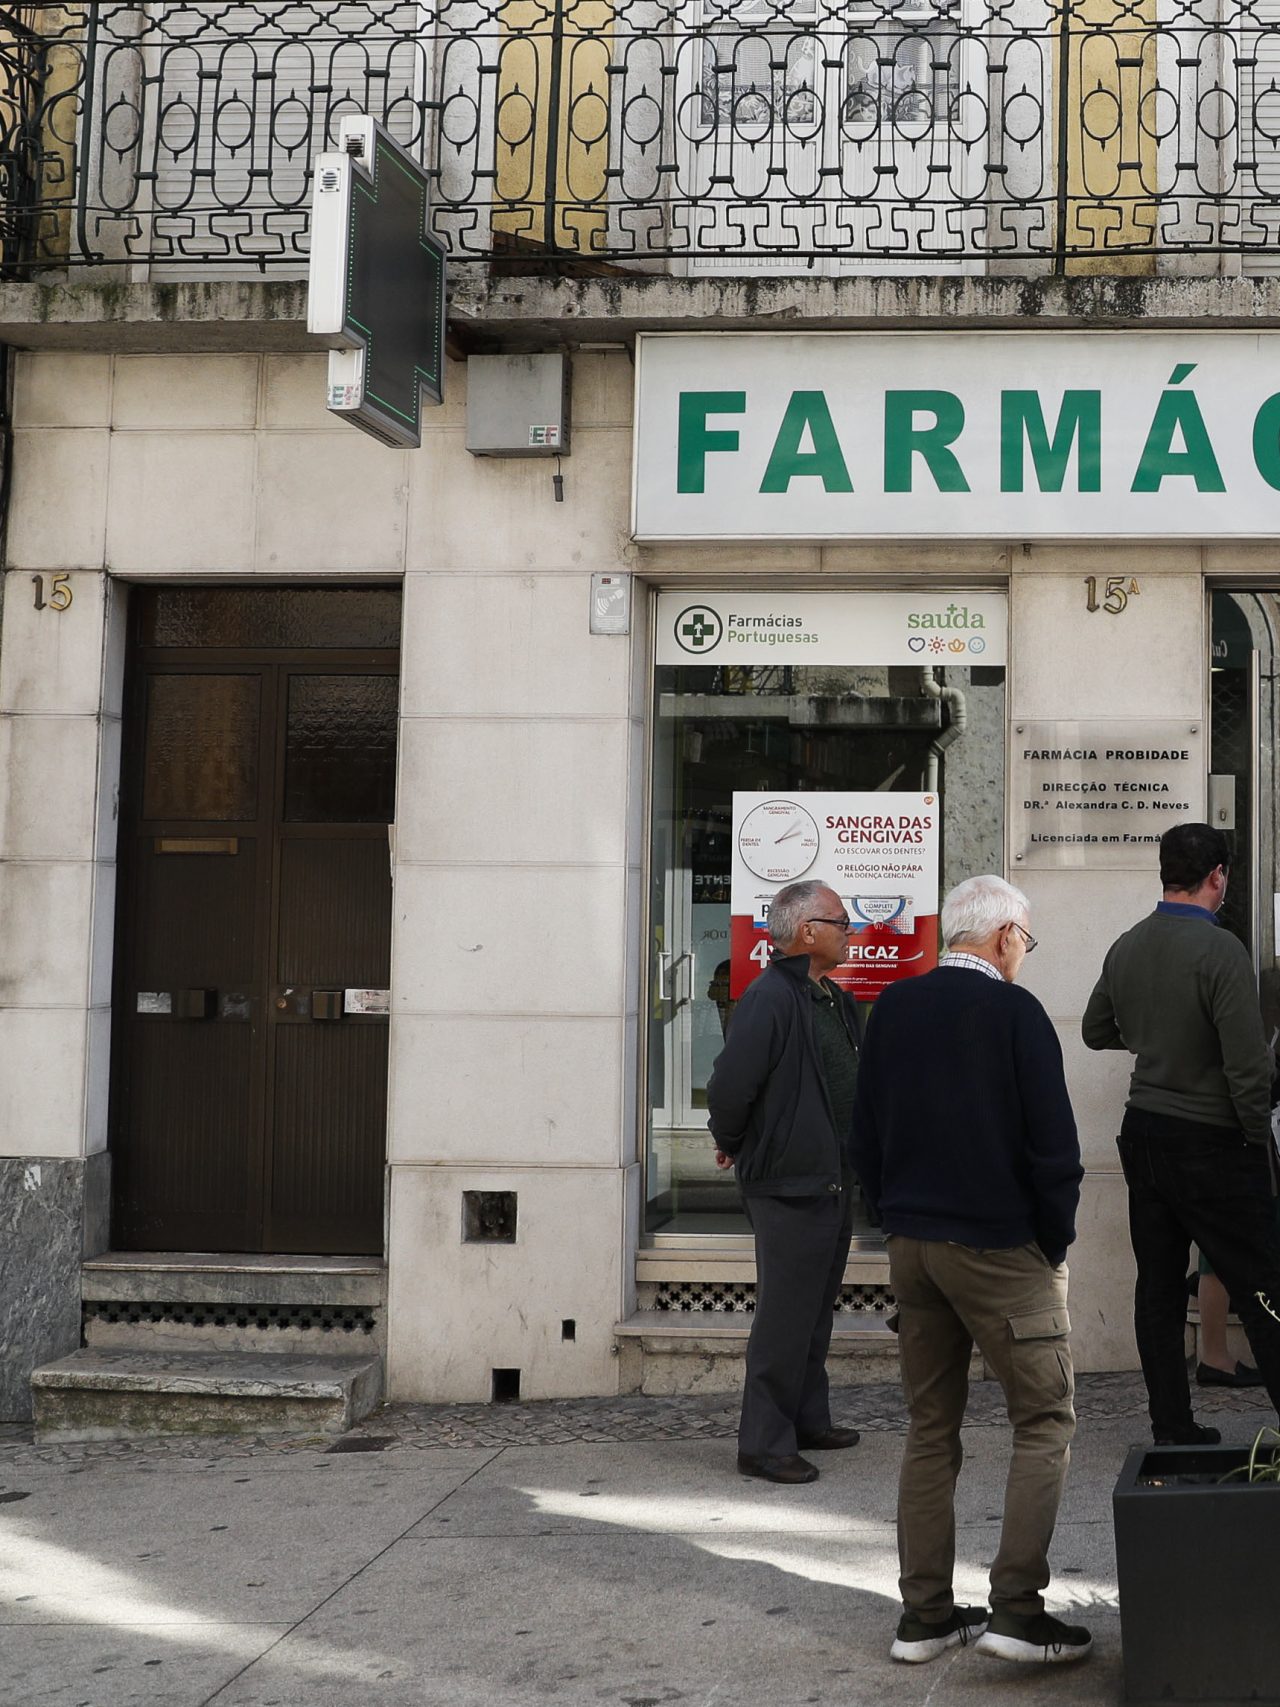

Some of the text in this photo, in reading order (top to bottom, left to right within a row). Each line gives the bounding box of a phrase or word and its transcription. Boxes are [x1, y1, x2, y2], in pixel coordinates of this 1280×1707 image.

[32, 574, 73, 612] 15
[728, 613, 803, 628] Farmácias
[727, 630, 819, 646] Portuguesas
[1023, 748, 1189, 760] FARMÁCIA PROBIDADE
[1042, 781, 1169, 793] DIRECÇÃO TÉCNICA
[1023, 800, 1190, 810] DR.ª Alexandra C. D. Neves
[825, 815, 932, 829] SANGRA DAS
[837, 830, 923, 843] GENGIVAS
[1031, 833, 1098, 843] Licenciada
[1123, 833, 1162, 843] Farmá
[834, 847, 926, 855] AO ESCOVAR OS DENTES?
[836, 862, 923, 872] O RELÓGIO NÃO PÁRA
[854, 872, 882, 880] DOENÇA
[846, 945, 899, 960] FICAZ
